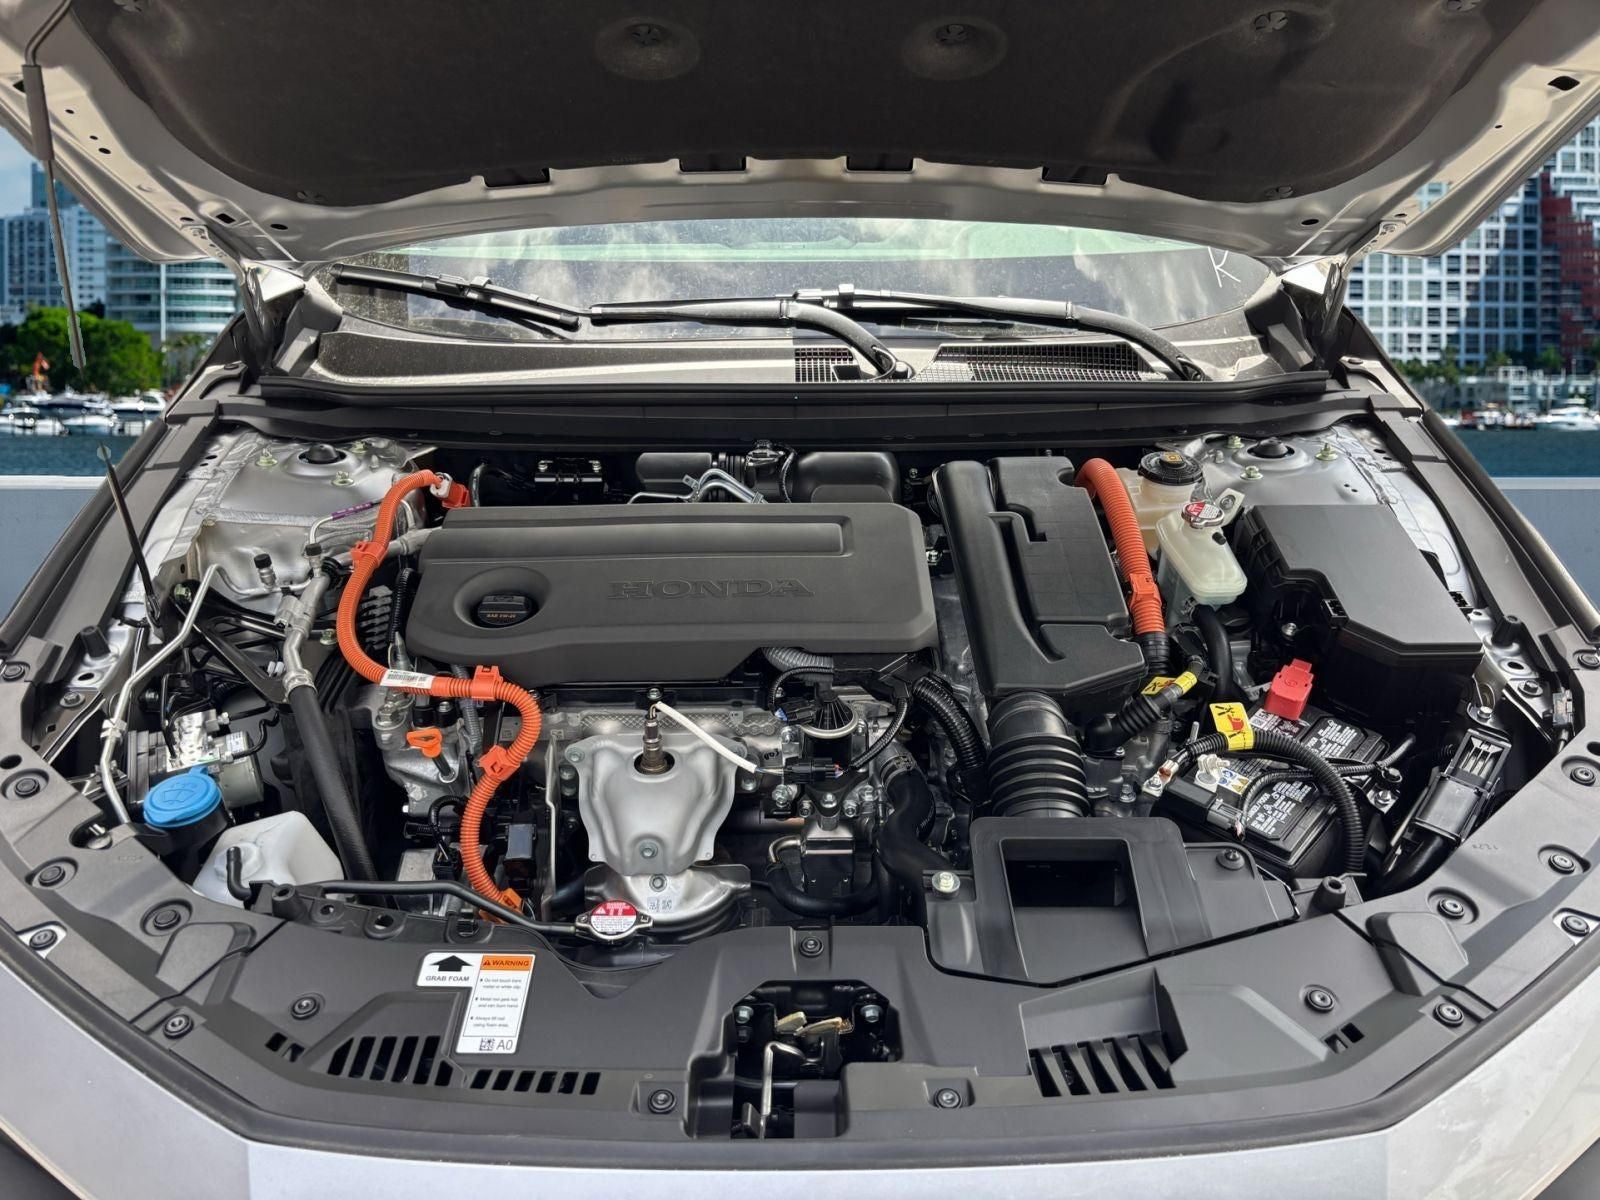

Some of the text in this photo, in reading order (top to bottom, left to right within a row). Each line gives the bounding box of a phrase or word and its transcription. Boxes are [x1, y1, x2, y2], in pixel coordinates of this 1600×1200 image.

[1207, 246, 1242, 288] K
[608, 577, 815, 599] HONDA
[496, 1039, 514, 1050] A0
